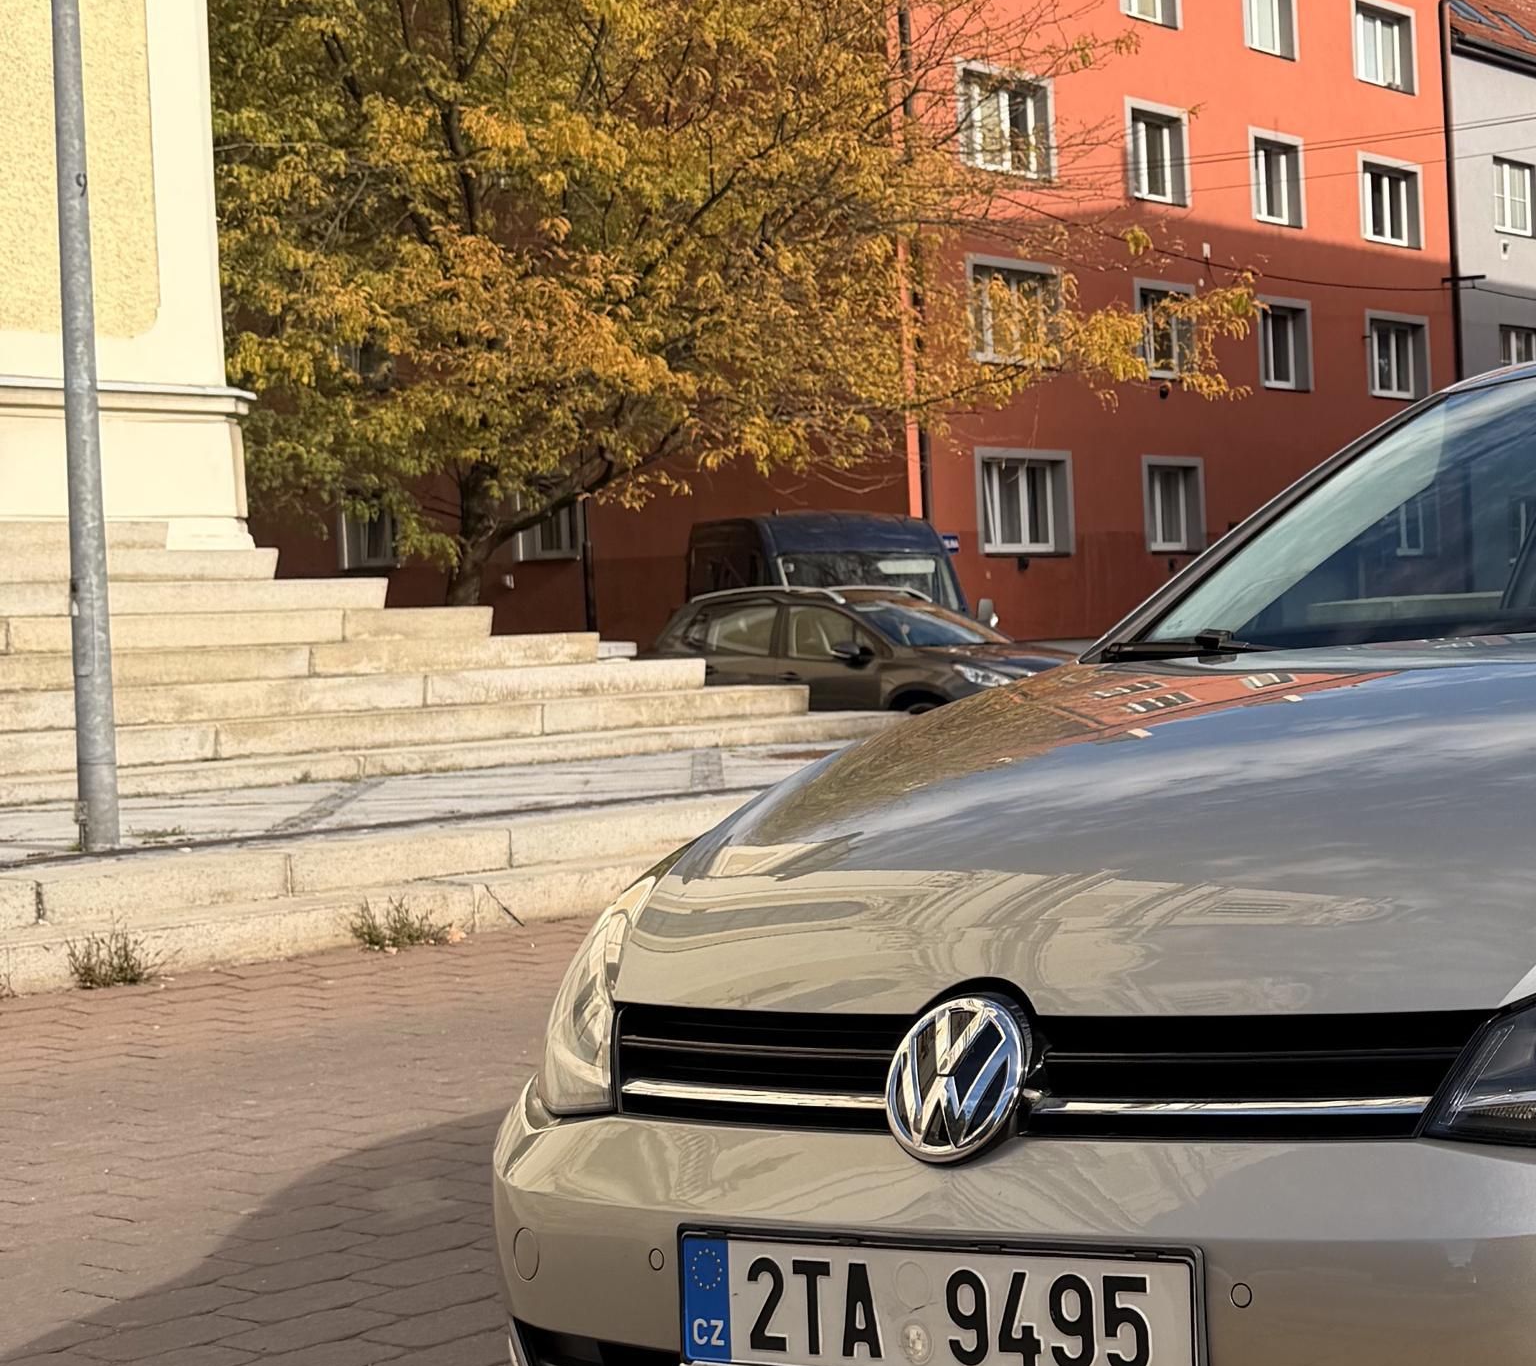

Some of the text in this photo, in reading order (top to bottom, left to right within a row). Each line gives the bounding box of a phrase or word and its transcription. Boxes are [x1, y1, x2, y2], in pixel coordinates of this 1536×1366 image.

[888, 1000, 1022, 1157] VW
[692, 1317, 726, 1347] CZ
[747, 1256, 883, 1359] 2TA
